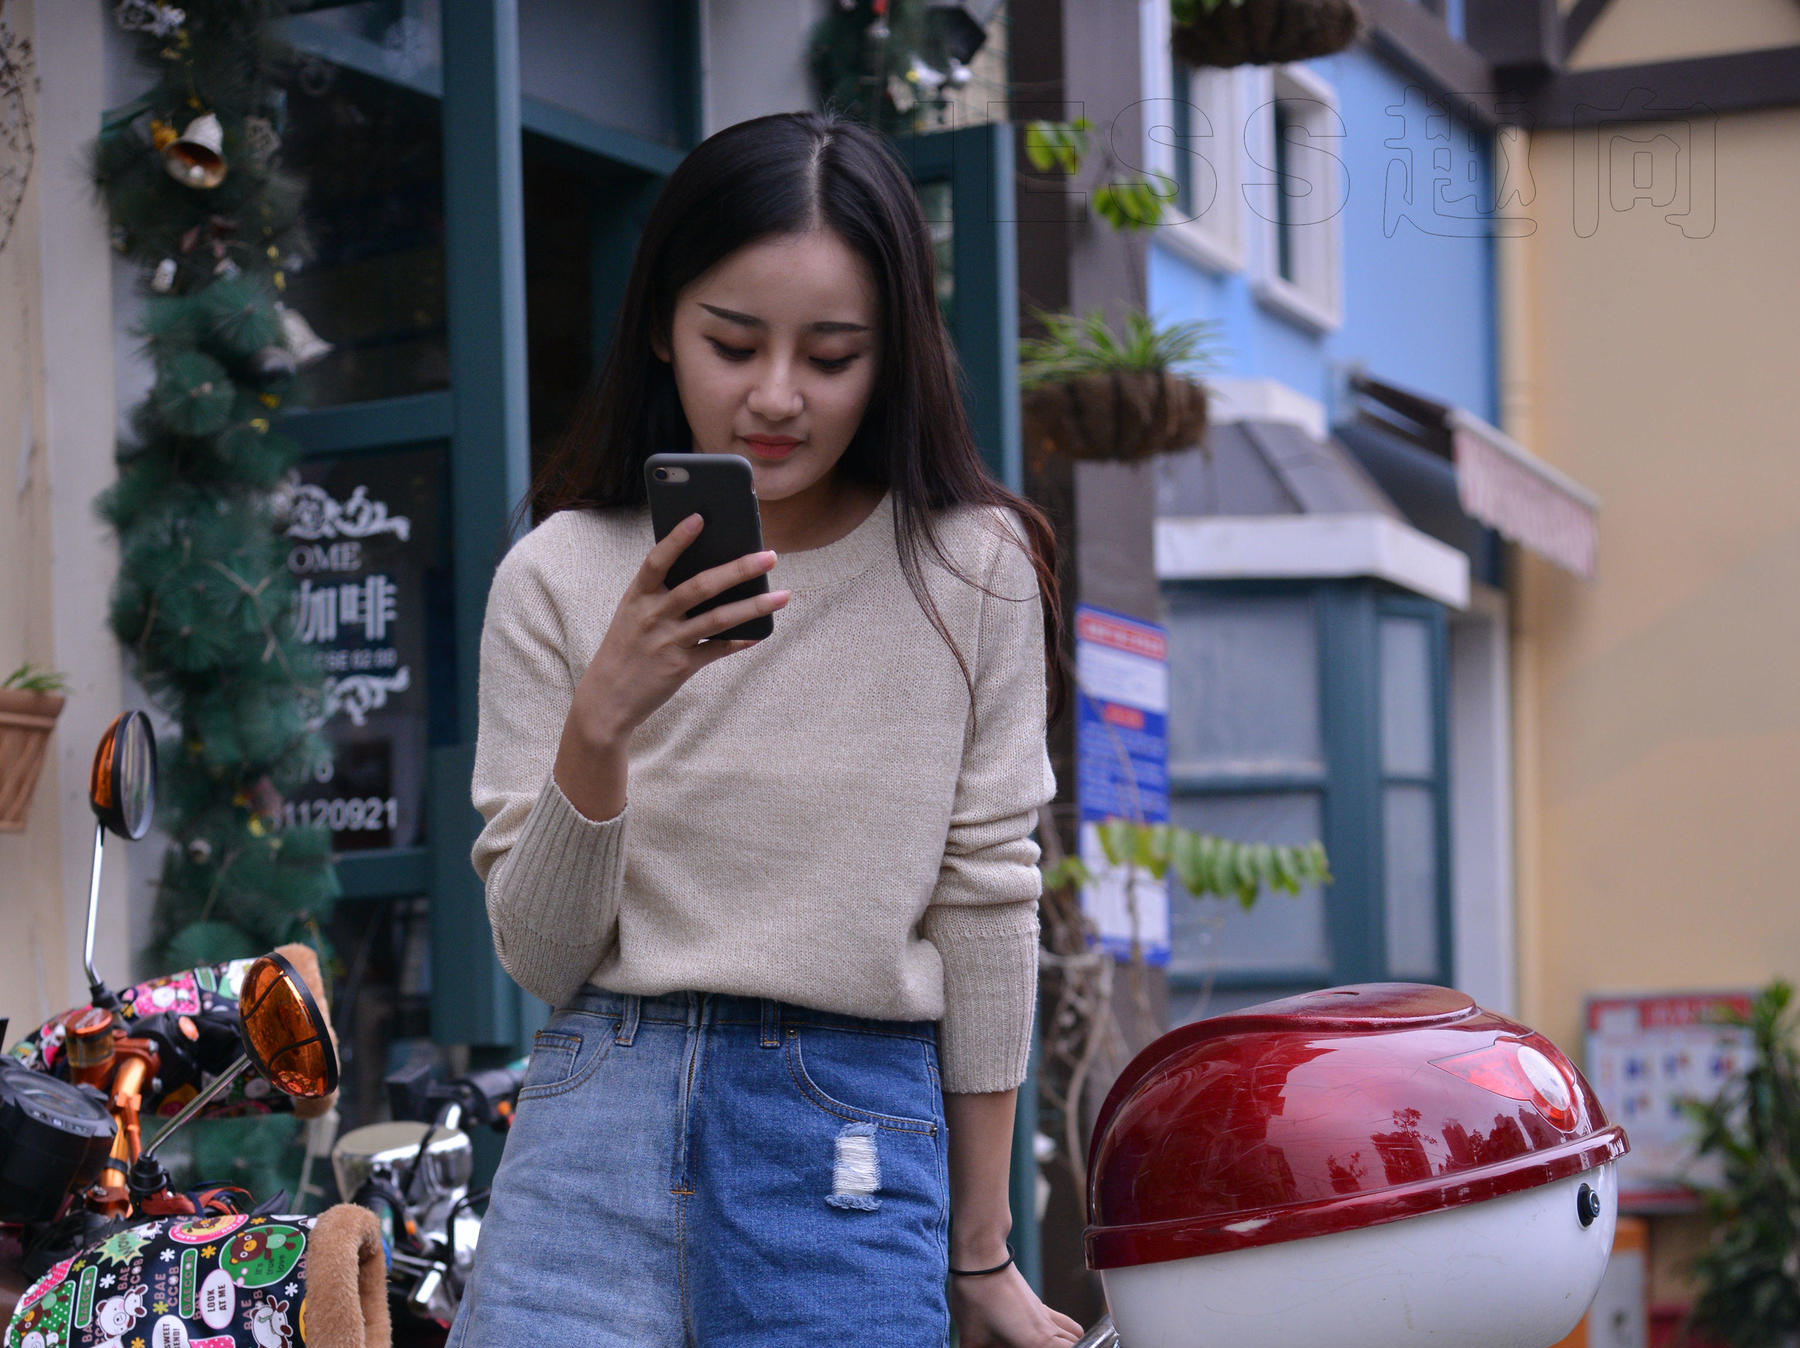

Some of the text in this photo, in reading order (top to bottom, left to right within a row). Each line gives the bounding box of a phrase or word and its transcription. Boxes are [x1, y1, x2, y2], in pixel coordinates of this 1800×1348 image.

[291, 575, 397, 643] 咖啡
[154, 1273, 166, 1300] BAE
[218, 1283, 227, 1311] AT ME
[207, 1289, 216, 1313] LOOK
